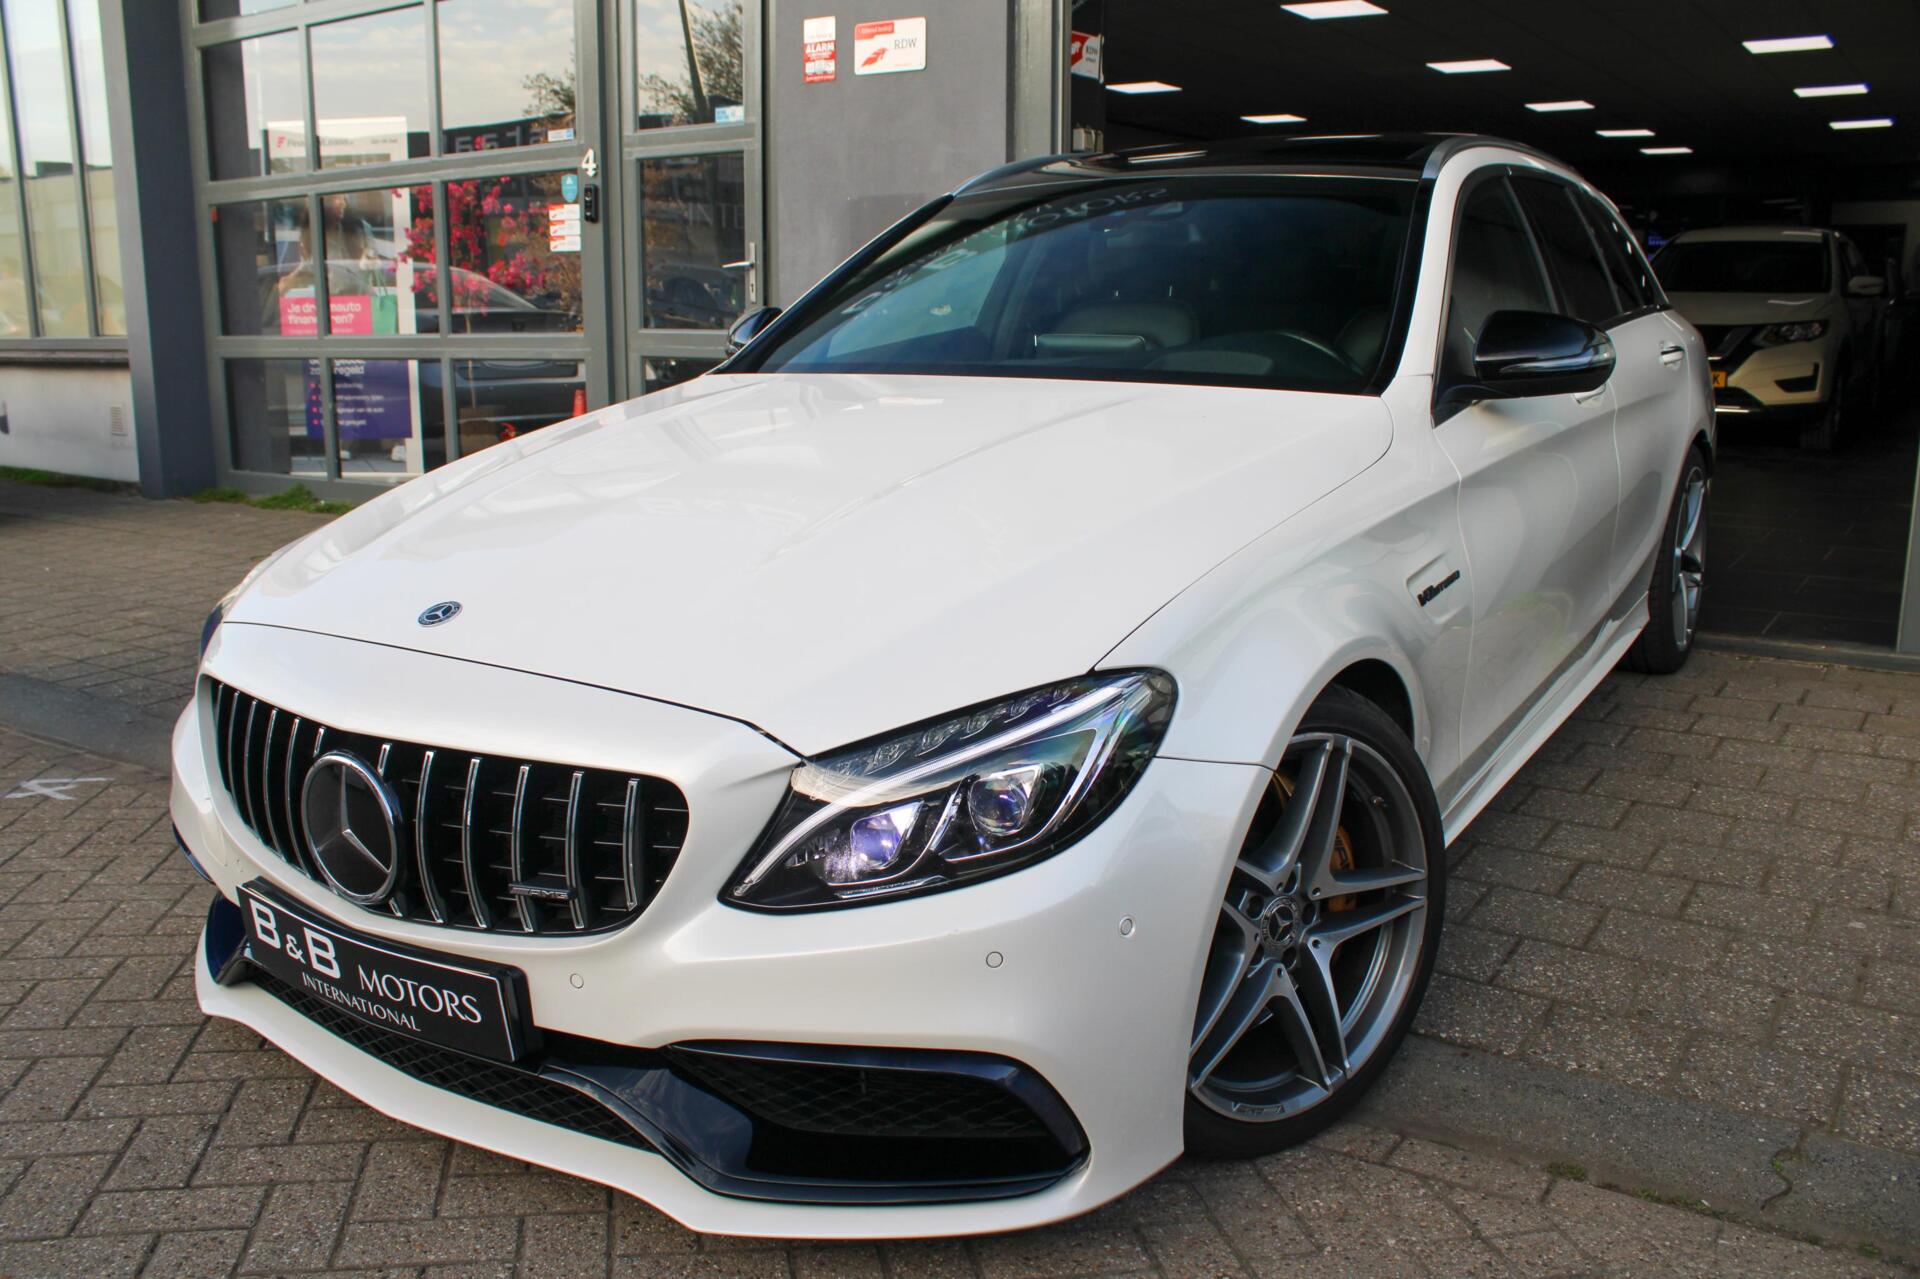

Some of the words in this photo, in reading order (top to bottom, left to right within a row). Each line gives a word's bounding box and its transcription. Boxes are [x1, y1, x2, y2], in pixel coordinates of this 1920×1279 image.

[805, 41, 835, 53] ALARM
[894, 37, 918, 50] RDW
[581, 148, 597, 177] 4
[287, 302, 300, 313] Je
[301, 971, 422, 1032] INTERNATIONAL
[357, 964, 482, 1024] MOTORS
